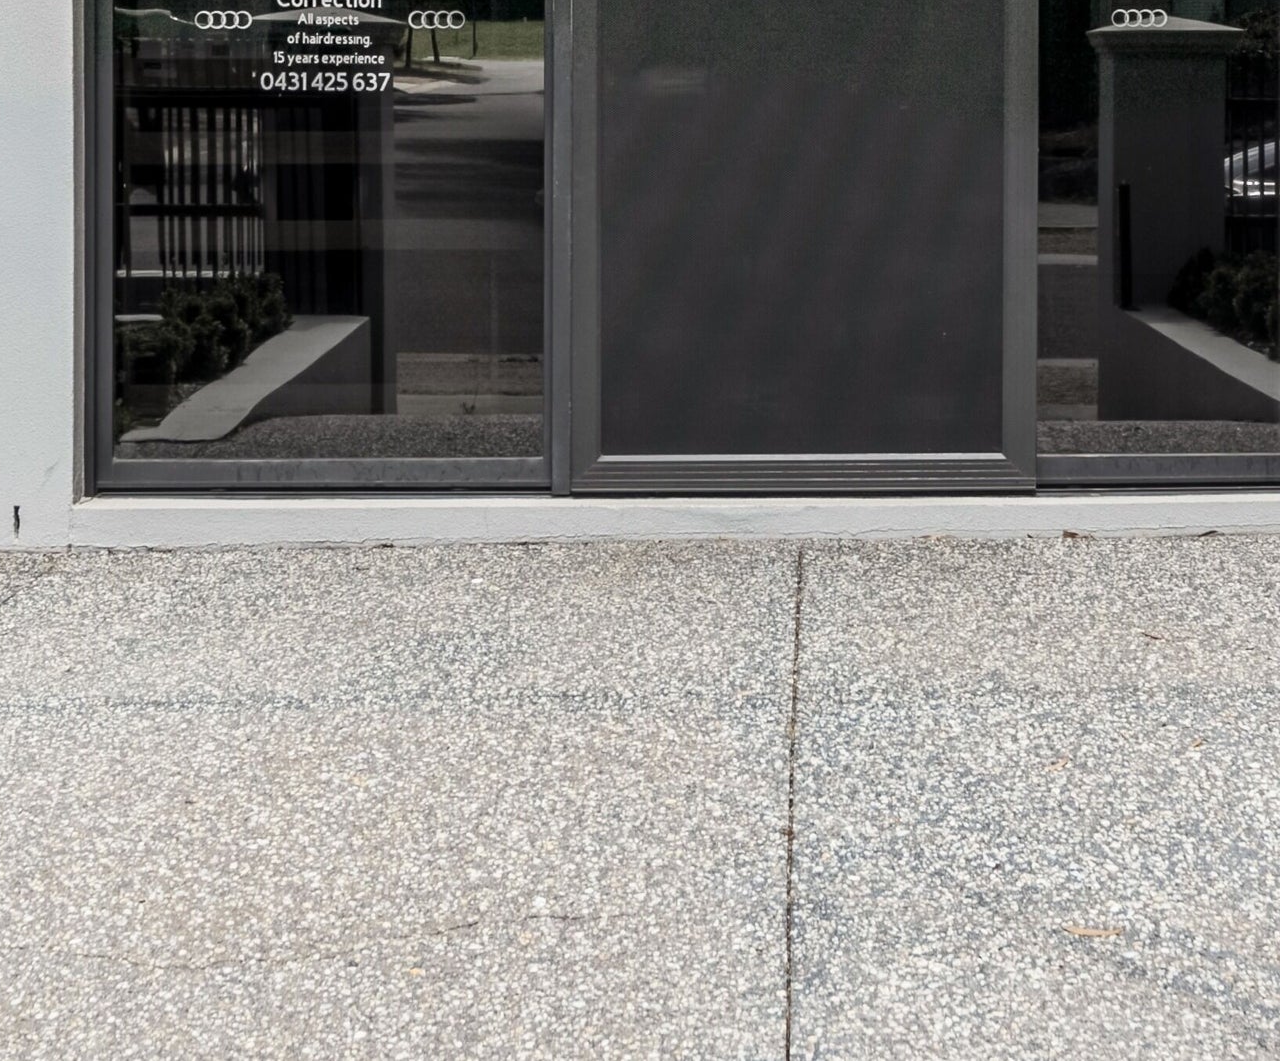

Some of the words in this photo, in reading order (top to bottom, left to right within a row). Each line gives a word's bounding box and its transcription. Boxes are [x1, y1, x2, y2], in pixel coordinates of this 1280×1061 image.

[297, 13, 314, 25] All
[315, 14, 359, 27] aspects
[287, 32, 300, 44] of
[302, 32, 373, 48] hairdressing.
[273, 51, 285, 64] 15
[287, 54, 320, 66] years
[321, 53, 385, 66] experience
[352, 72, 391, 91] 637
